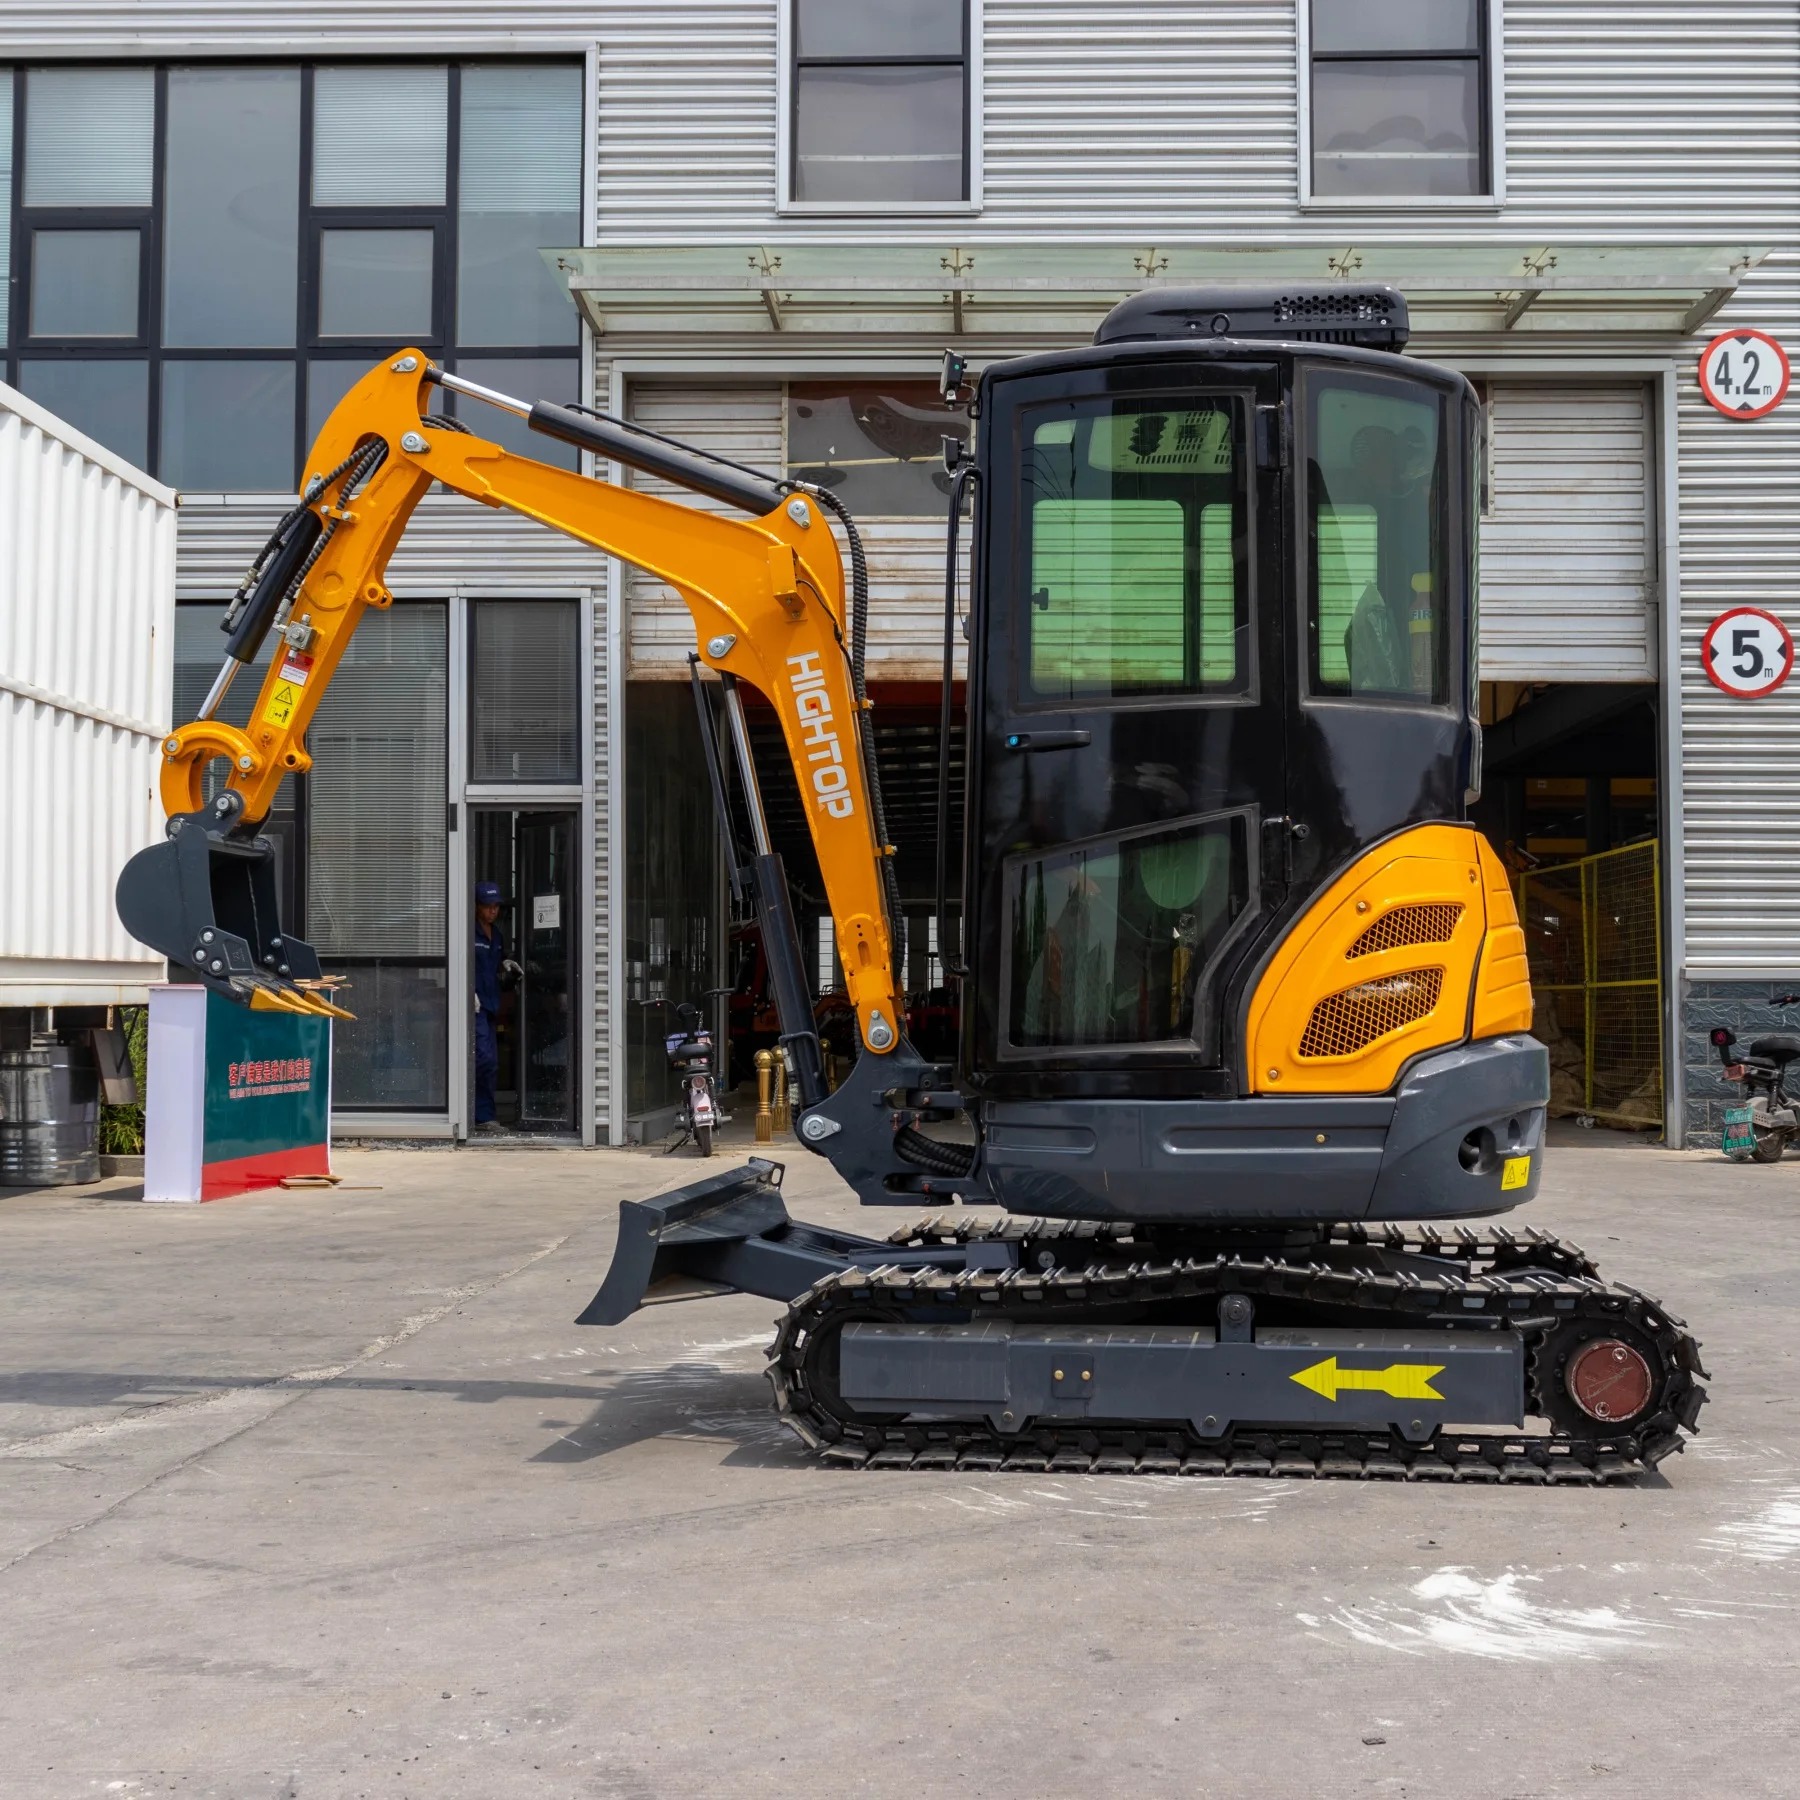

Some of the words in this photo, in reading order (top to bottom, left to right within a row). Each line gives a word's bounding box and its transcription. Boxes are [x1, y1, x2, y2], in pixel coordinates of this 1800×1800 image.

[1411, 610, 1432, 620] FIR
[786, 651, 854, 819] HIGHTOP
[228, 1057, 311, 1086] 客户满意是我们的宗旨
